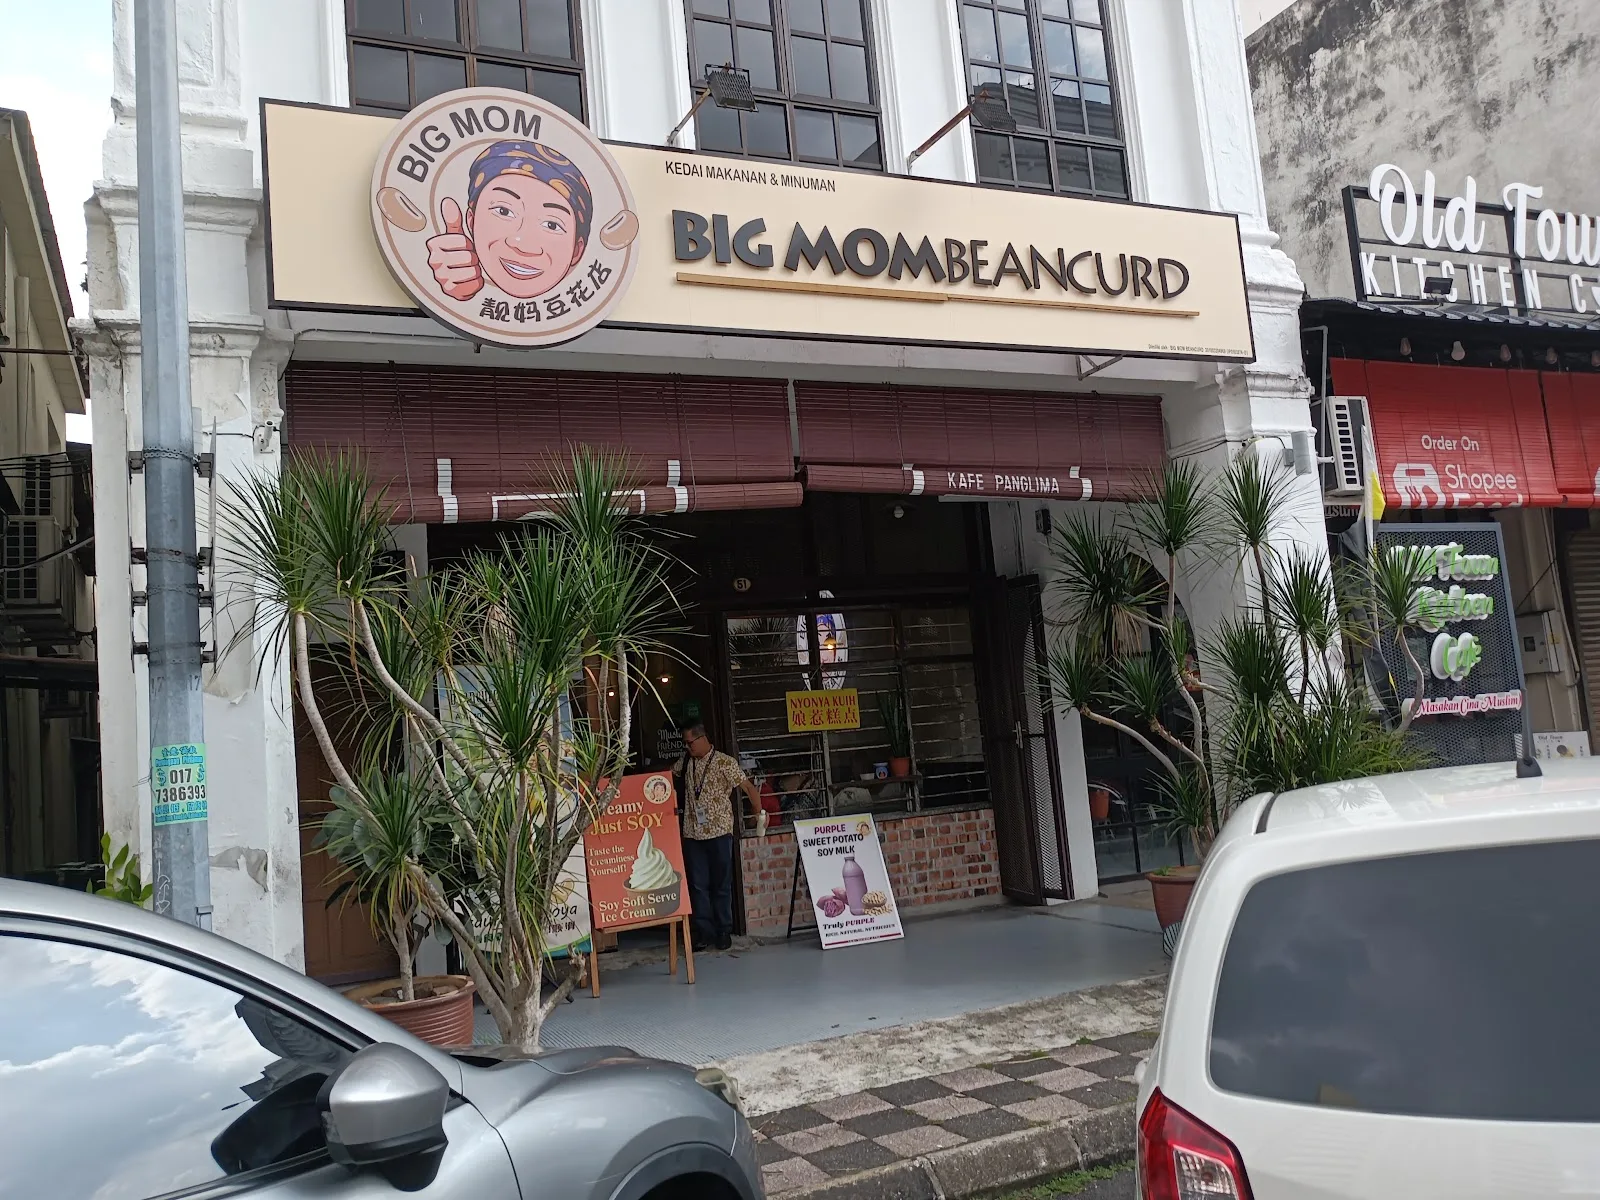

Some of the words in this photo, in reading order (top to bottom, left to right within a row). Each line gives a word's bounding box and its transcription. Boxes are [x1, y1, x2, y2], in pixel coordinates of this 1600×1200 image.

[397, 125, 451, 183] BIG
[449, 105, 542, 140] MOM
[665, 161, 703, 177] KEDAI
[706, 166, 767, 184] MAKANAN
[770, 173, 778, 186] &
[781, 174, 836, 192] MINUMAN
[1368, 163, 1486, 253] Old
[671, 209, 774, 268] BIG
[1360, 252, 1543, 310] KITCHEN
[479, 259, 613, 323] 靓妈豆花店
[1421, 434, 1457, 450] Order
[1461, 435, 1480, 451] On
[947, 472, 985, 490] KAFE
[995, 474, 1060, 494] PANGLIMA
[1445, 464, 1517, 495] Shopee
[1440, 542, 1499, 578] Town
[736, 579, 747, 590] 51
[790, 695, 830, 709] NYONYA
[832, 694, 856, 707] KUIH
[1460, 697, 1479, 716] Cina
[1481, 691, 1523, 712] Muslim)
[792, 708, 858, 726] 娘惹糕点
[169, 768, 192, 785] 017
[155, 784, 206, 804] 7386393
[590, 801, 644, 817] eamy
[590, 819, 623, 836] Just
[627, 812, 664, 832] SOY
[814, 823, 846, 835] PURPLE
[803, 836, 832, 848] SWEET
[832, 833, 864, 844] POTATO
[588, 847, 611, 857] Taste
[612, 845, 625, 854] the
[817, 847, 834, 857] SOY
[835, 845, 855, 855] MILK
[589, 854, 635, 867] Creaminess
[590, 864, 628, 877] Yourself!
[599, 899, 620, 912] Soy
[622, 894, 646, 908] Soft
[647, 891, 678, 905] Serve
[551, 905, 578, 920] oya
[600, 911, 617, 923] Ice
[620, 907, 656, 921] Cream
[823, 922, 844, 931] Truly
[845, 917, 875, 927] PURPLE
